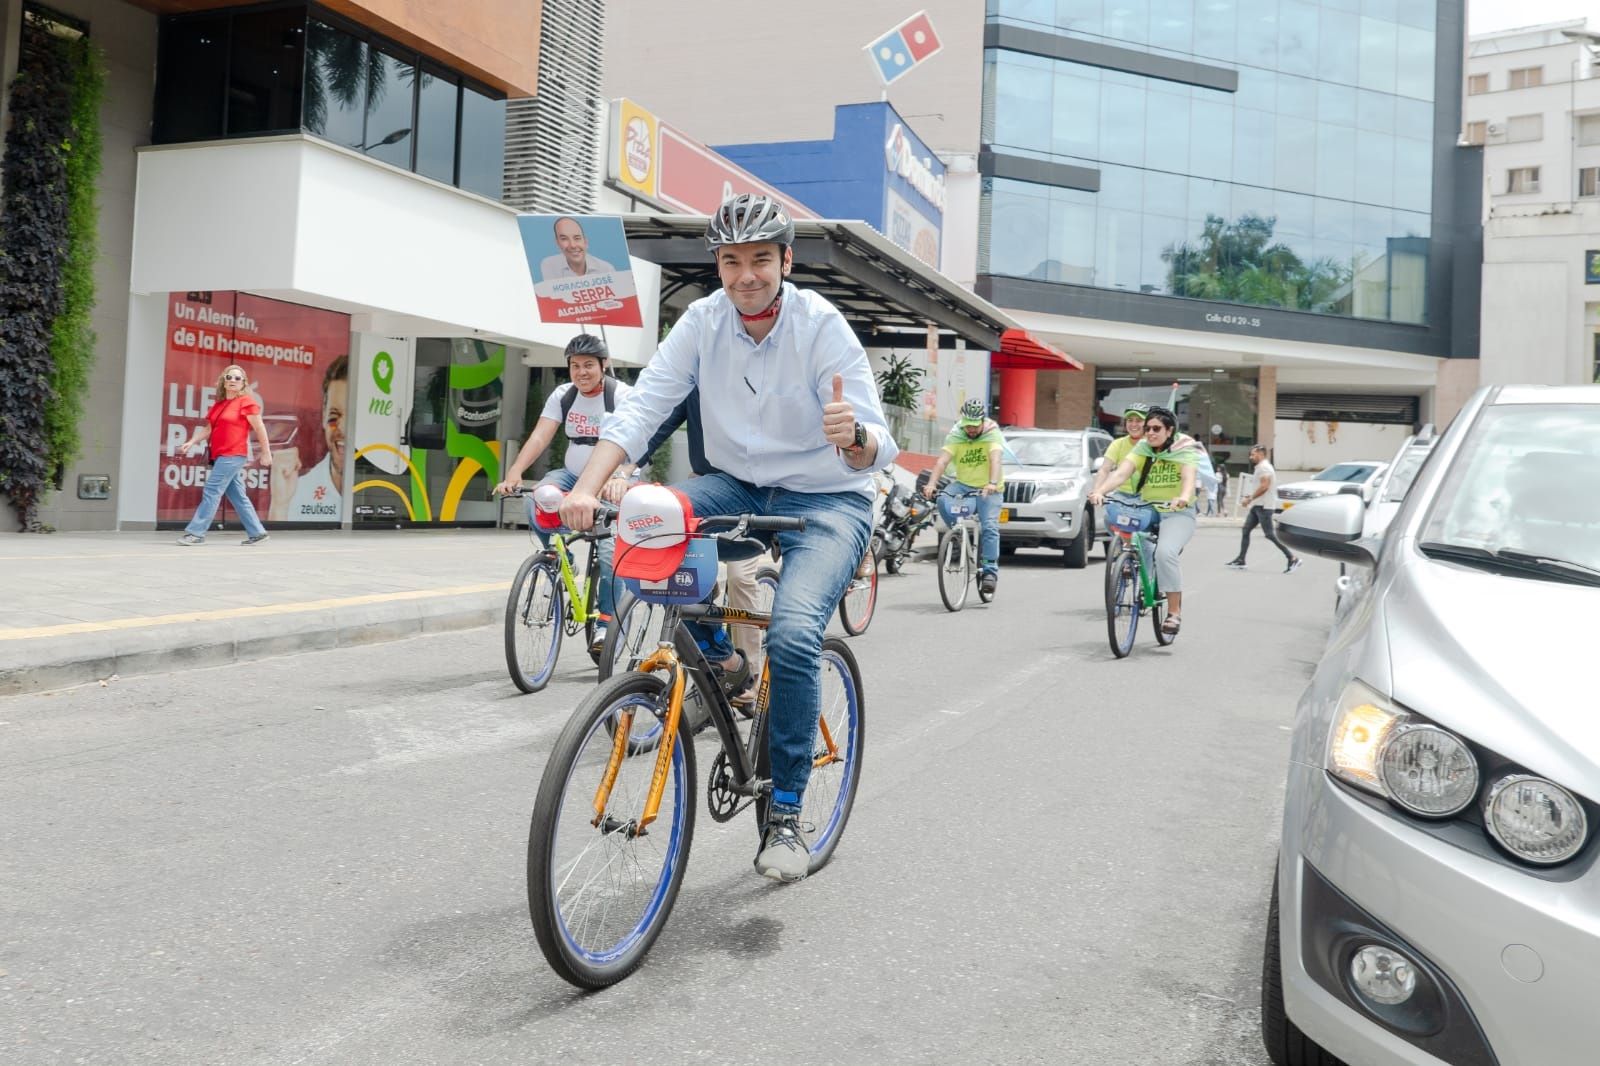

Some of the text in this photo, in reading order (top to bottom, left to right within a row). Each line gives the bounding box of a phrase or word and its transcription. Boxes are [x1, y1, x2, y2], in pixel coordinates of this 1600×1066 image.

[591, 274, 614, 285] JOSÉ
[571, 285, 616, 303] SERPA
[174, 302, 259, 333] Un Alemán,
[557, 303, 598, 318] ALCALDE
[173, 328, 314, 366] de la homeopatía
[167, 380, 264, 421] LLE
[368, 397, 394, 417] me
[575, 424, 601, 436] GEN
[163, 464, 270, 489] QUERSE
[1149, 463, 1177, 475] AIME
[1145, 472, 1182, 484] NDRES
[627, 515, 664, 530] SERPA
[675, 573, 693, 584] FIA
